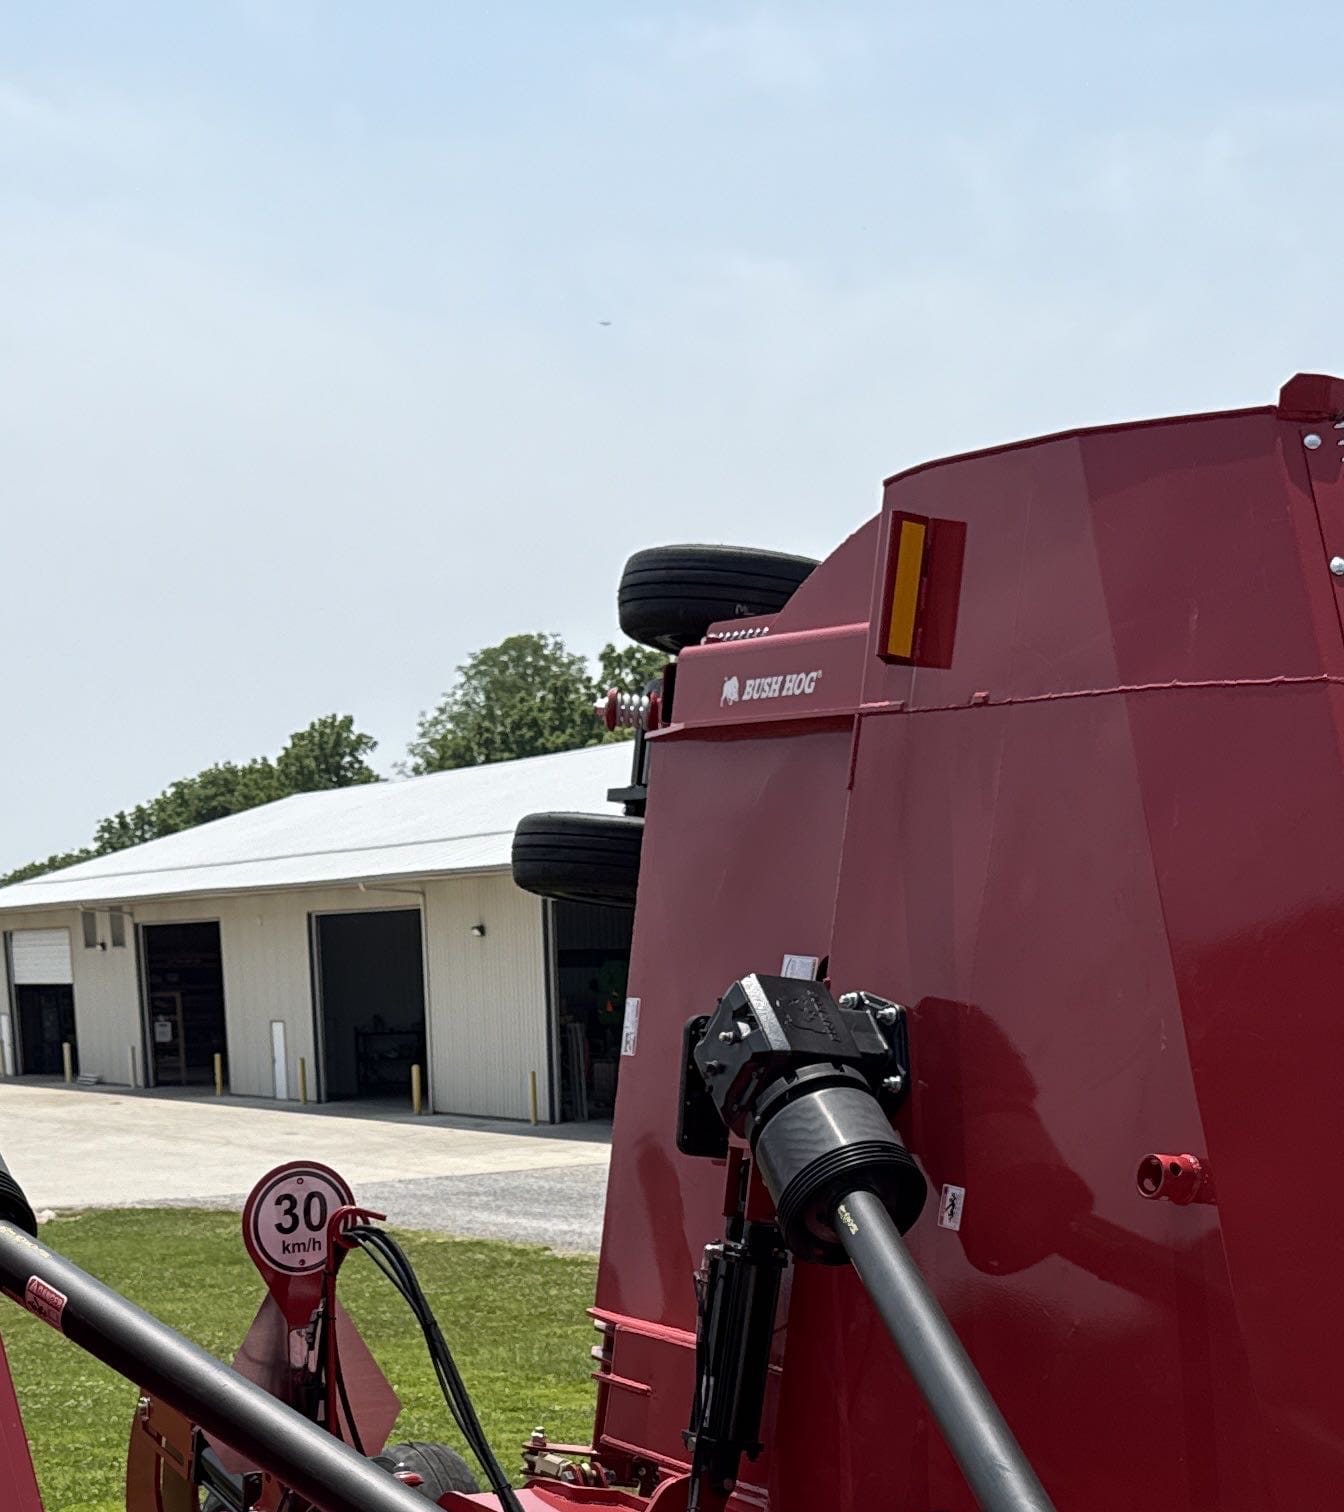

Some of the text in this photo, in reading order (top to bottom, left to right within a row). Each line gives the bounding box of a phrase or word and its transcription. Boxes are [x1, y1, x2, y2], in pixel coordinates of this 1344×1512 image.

[741, 672, 818, 701] BUSH HOG
[274, 1190, 328, 1235] 30
[282, 1237, 322, 1255] km/h
